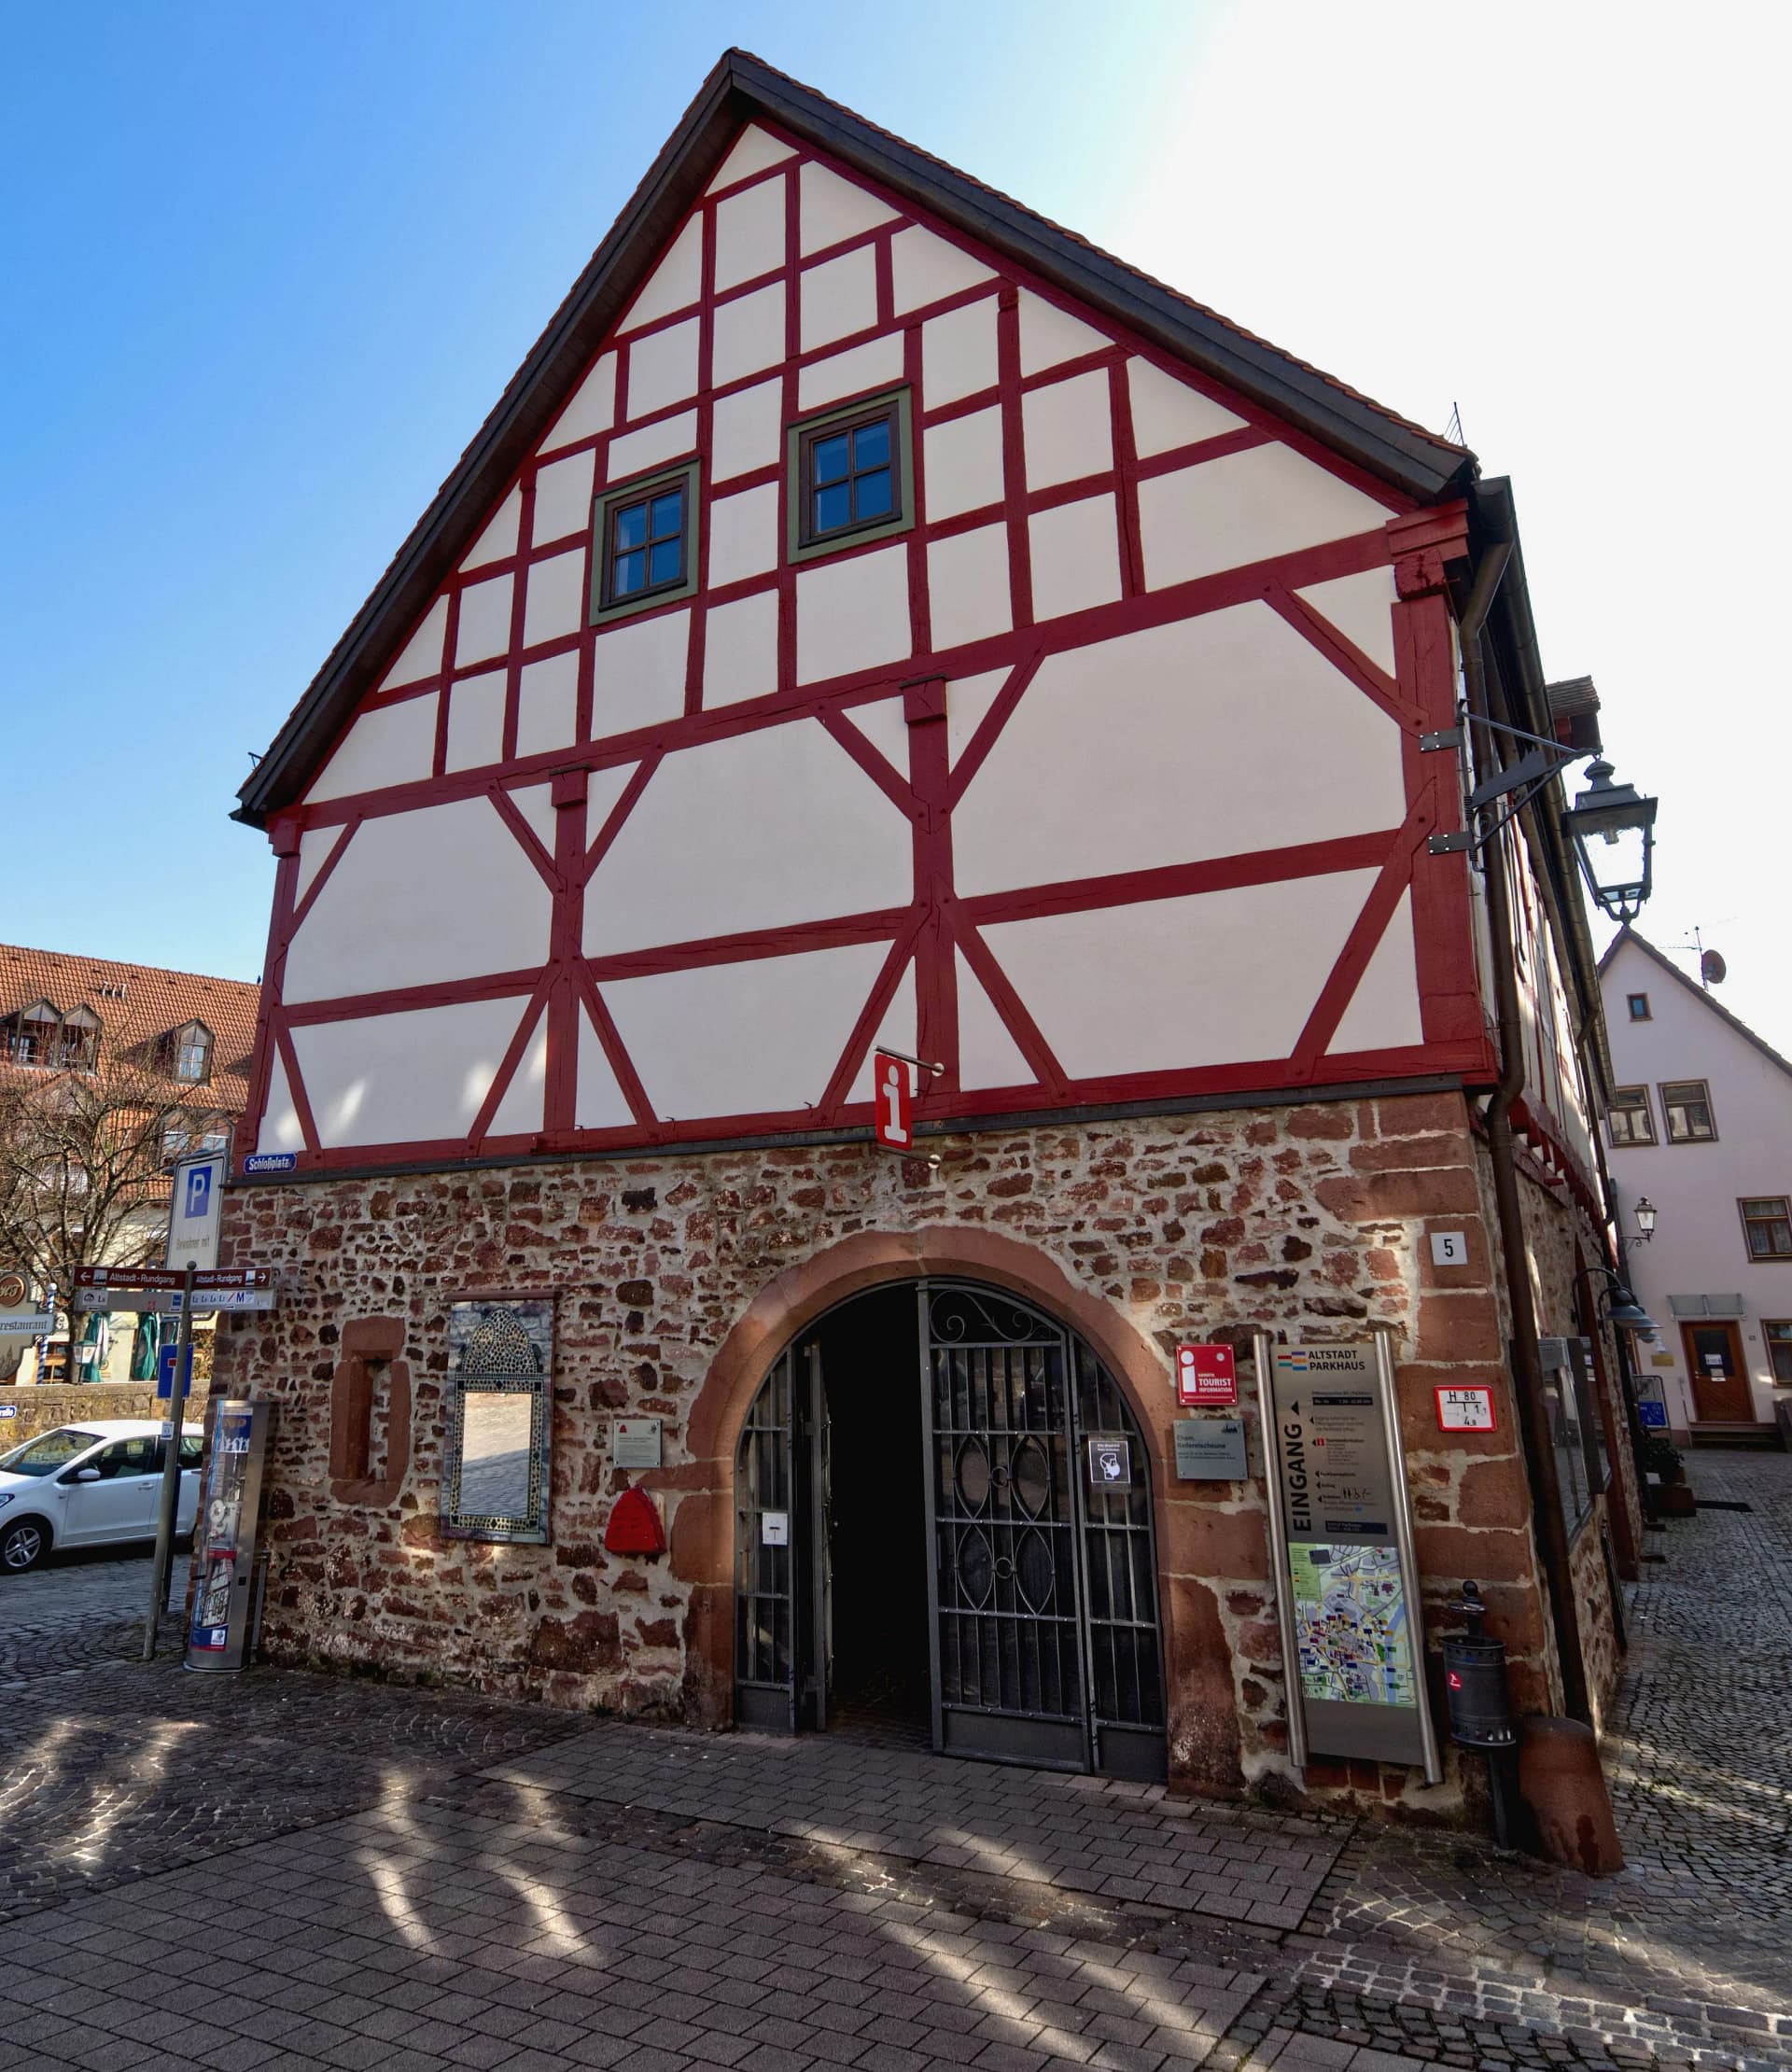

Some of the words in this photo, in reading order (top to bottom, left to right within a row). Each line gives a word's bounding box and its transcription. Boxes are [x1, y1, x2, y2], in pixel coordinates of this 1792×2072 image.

[248, 1156, 289, 1170] Schloßplatz
[189, 1173, 205, 1212] P
[1443, 1239, 1454, 1258] 5
[1308, 1350, 1358, 1360] ALTSTADT
[1309, 1361, 1365, 1371] PARKHAUS
[1197, 1378, 1232, 1387] TOURIST
[1283, 1423, 1312, 1532] EINGANG
